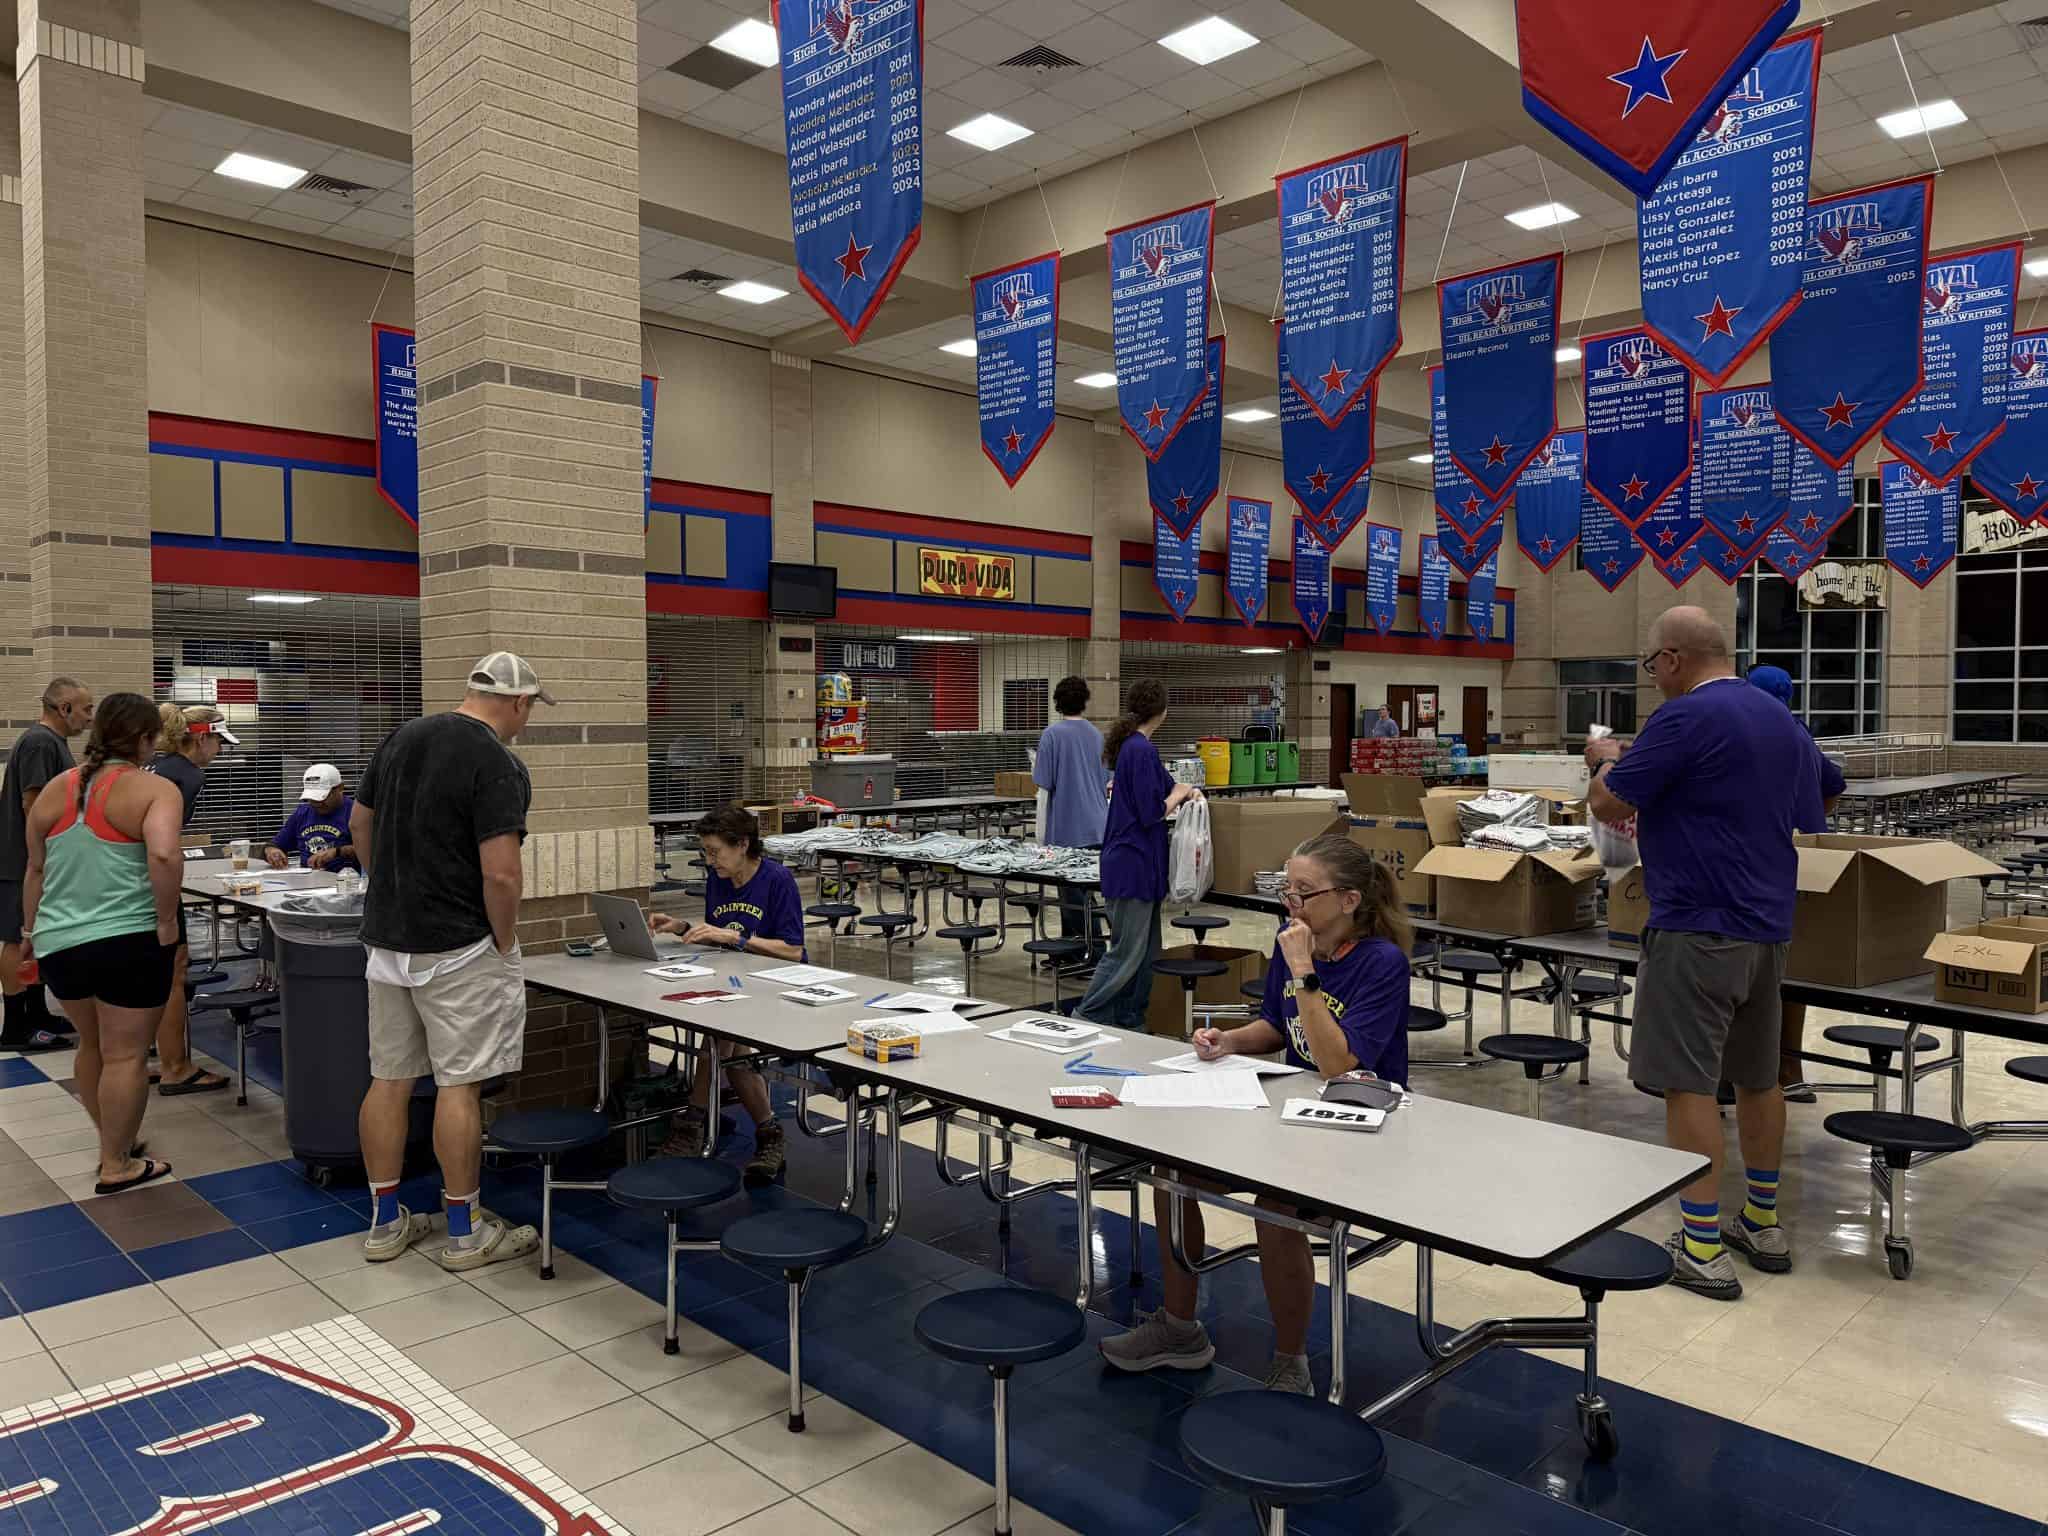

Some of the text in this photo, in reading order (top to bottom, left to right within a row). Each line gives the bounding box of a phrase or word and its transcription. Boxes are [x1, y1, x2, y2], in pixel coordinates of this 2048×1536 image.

[868, 0, 907, 24] SCHOOL
[793, 43, 816, 61] HIGH
[806, 37, 891, 86] UIL COPY EDITING
[790, 52, 911, 120] Alondra Melendez 2021
[791, 87, 917, 153] Alondra Melendez 2022
[829, 91, 876, 118] Melendez
[1747, 98, 1798, 119] SCHOOL
[791, 105, 917, 169] Angel Velasquez 2022
[1692, 132, 1773, 163] ACCOUNTING
[791, 125, 919, 188] Alexis Ibarra 2022
[1683, 146, 1803, 187] Ibarra 2021
[793, 158, 919, 218] Katia Mendoza 2023
[1307, 163, 1368, 208] ROYAL
[1642, 160, 1804, 210] Ian Arteaga 2022
[1642, 176, 1804, 225] Lissy Gonzalez 2022
[795, 176, 920, 235] Katia Mendoza 2024
[1292, 191, 1391, 225] HIGH SCHOOL
[1643, 192, 1805, 238] Litzie Gonzalez 2022
[1133, 225, 1183, 264] ROYAL
[1297, 215, 1381, 246] UIL SOCIAL STUDIES
[1642, 221, 1804, 265] Alexis Ibarra 2022
[1643, 206, 1805, 252] Paola Gonzalez 2022
[1867, 231, 1912, 248] SCHOOL
[1285, 254, 1308, 267] Jesus
[1309, 241, 1355, 260] Hernandez
[1285, 242, 1393, 279] Jesus Hernandez 2015
[1326, 253, 1393, 279] Price 2019
[1641, 236, 1804, 280] Samantha Lopez 2022
[1818, 258, 1887, 280] COPY EDITING
[1285, 265, 1393, 301] Angeles Garcia 2021
[1641, 252, 1802, 292] Nancy Cruz 2024
[1802, 271, 1917, 299] Castro 2025
[1285, 277, 1393, 314] Martin Mendoza 2021
[1301, 304, 1334, 320] Arteaga
[1372, 288, 1395, 304] 2022
[1467, 274, 1526, 313] ROYAL
[1966, 288, 2003, 301] SCHOOL
[1286, 301, 1394, 336] Jennifer Hernandez 2024
[1501, 319, 1538, 335] WRITING
[1959, 307, 2002, 321] WRITING
[1984, 322, 2008, 333] 2021
[1446, 333, 1551, 361] Eleanor Recinos 2025
[1927, 343, 2008, 362] Torres 2022
[1984, 332, 2009, 343] 2022
[1982, 351, 2007, 363] 2023
[1983, 362, 2007, 373] 2023
[1919, 402, 1957, 412] Recinos
[1982, 394, 2006, 405] 2025
[1920, 393, 1950, 404] Garcia
[1982, 384, 2006, 395] 2024
[923, 557, 1011, 593] PURA VIDA
[1815, 573, 1882, 593] home of the
[1297, 1108, 1368, 1122] 1267
